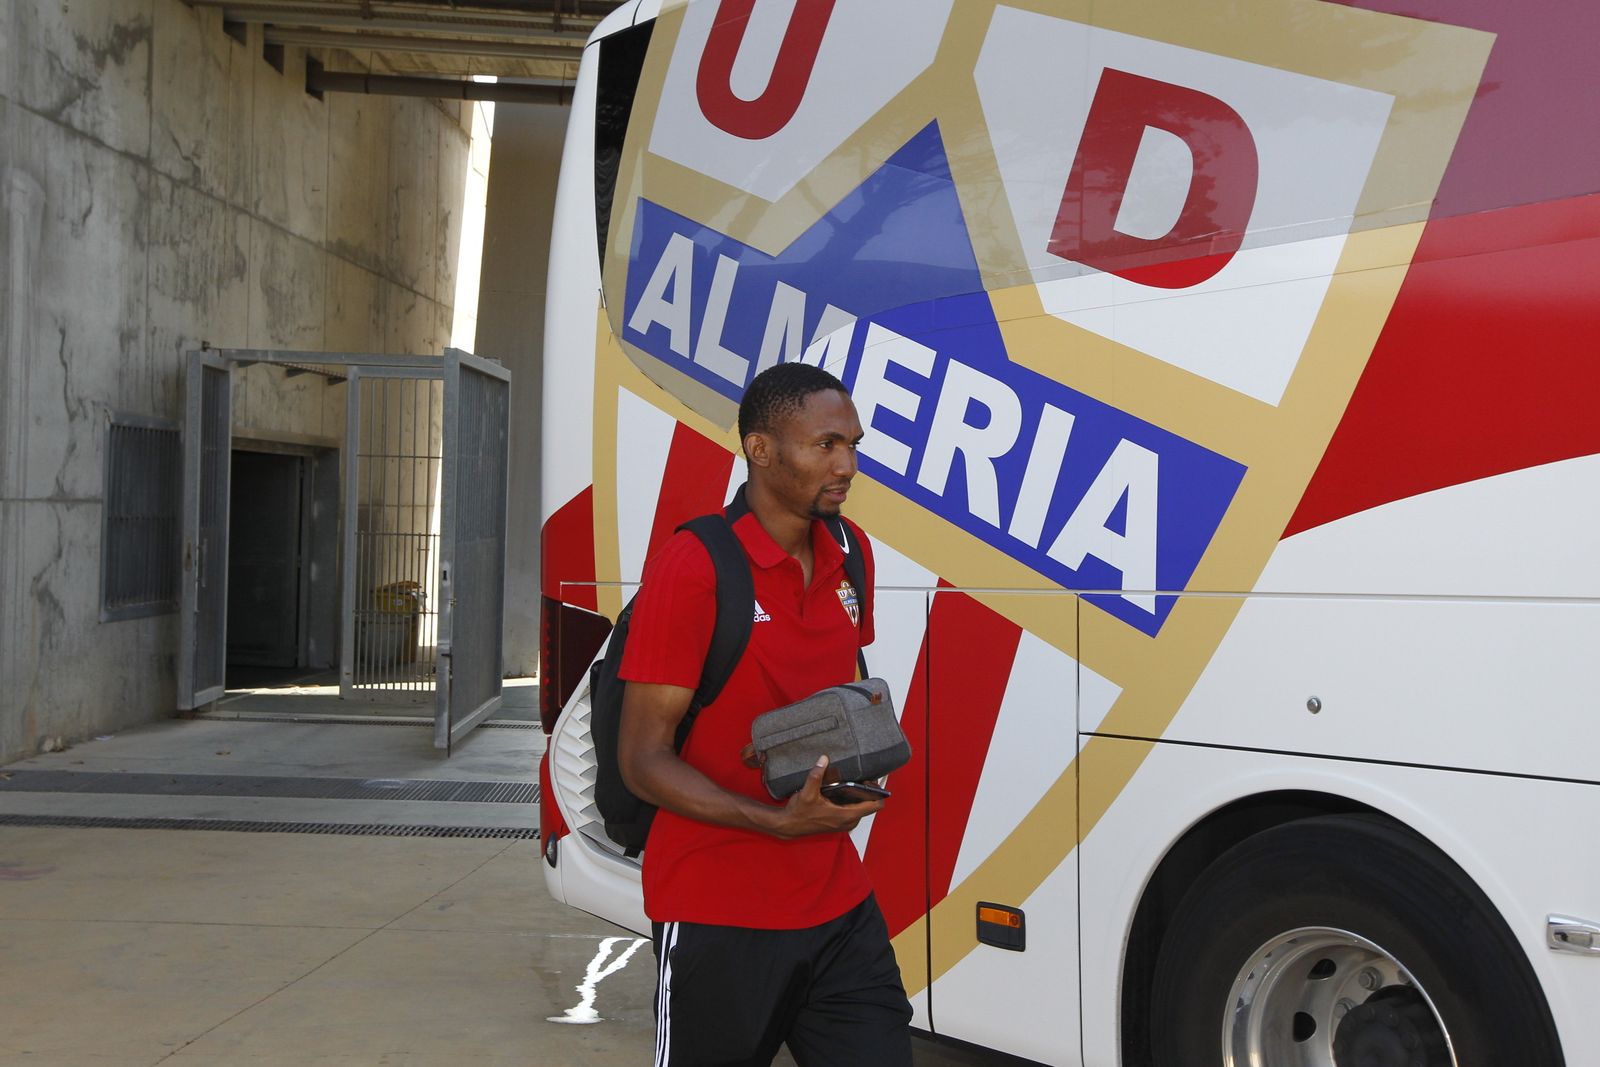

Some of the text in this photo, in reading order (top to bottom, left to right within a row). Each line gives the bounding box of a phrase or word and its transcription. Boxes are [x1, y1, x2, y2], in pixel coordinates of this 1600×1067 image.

[696, 0, 1259, 289] U D
[628, 232, 1159, 615] ALMERIA
[754, 613, 771, 622] das
